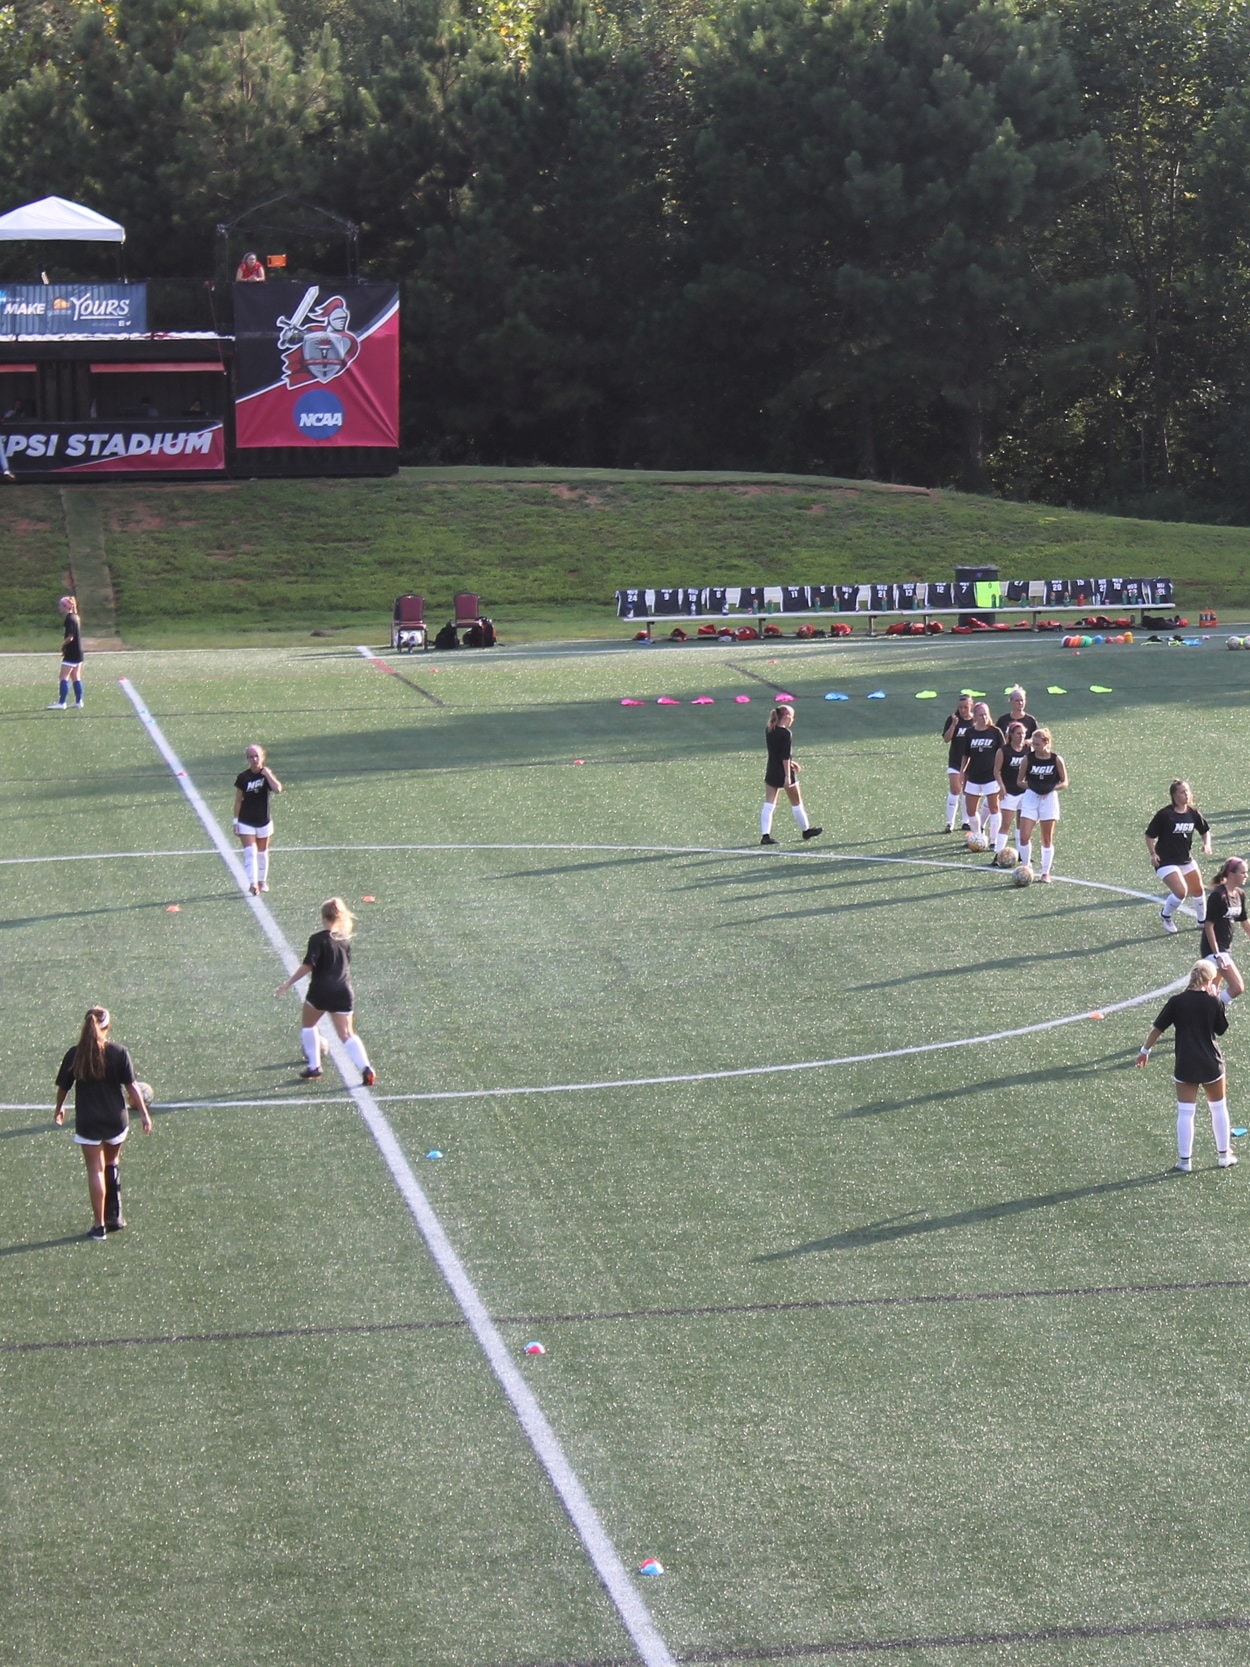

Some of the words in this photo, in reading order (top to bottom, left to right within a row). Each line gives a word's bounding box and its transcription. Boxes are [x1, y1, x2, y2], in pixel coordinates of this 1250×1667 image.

[4, 303, 46, 315] MAKE
[70, 292, 130, 320] YOURS
[299, 413, 342, 427] NCAA
[65, 432, 213, 456] STADIUM
[790, 590, 798, 598] 11
[936, 586, 945, 594] 12
[627, 594, 638, 602] 24
[970, 738, 993, 746] NGU
[1030, 765, 1055, 773] NGU
[1174, 823, 1195, 831] NGU
